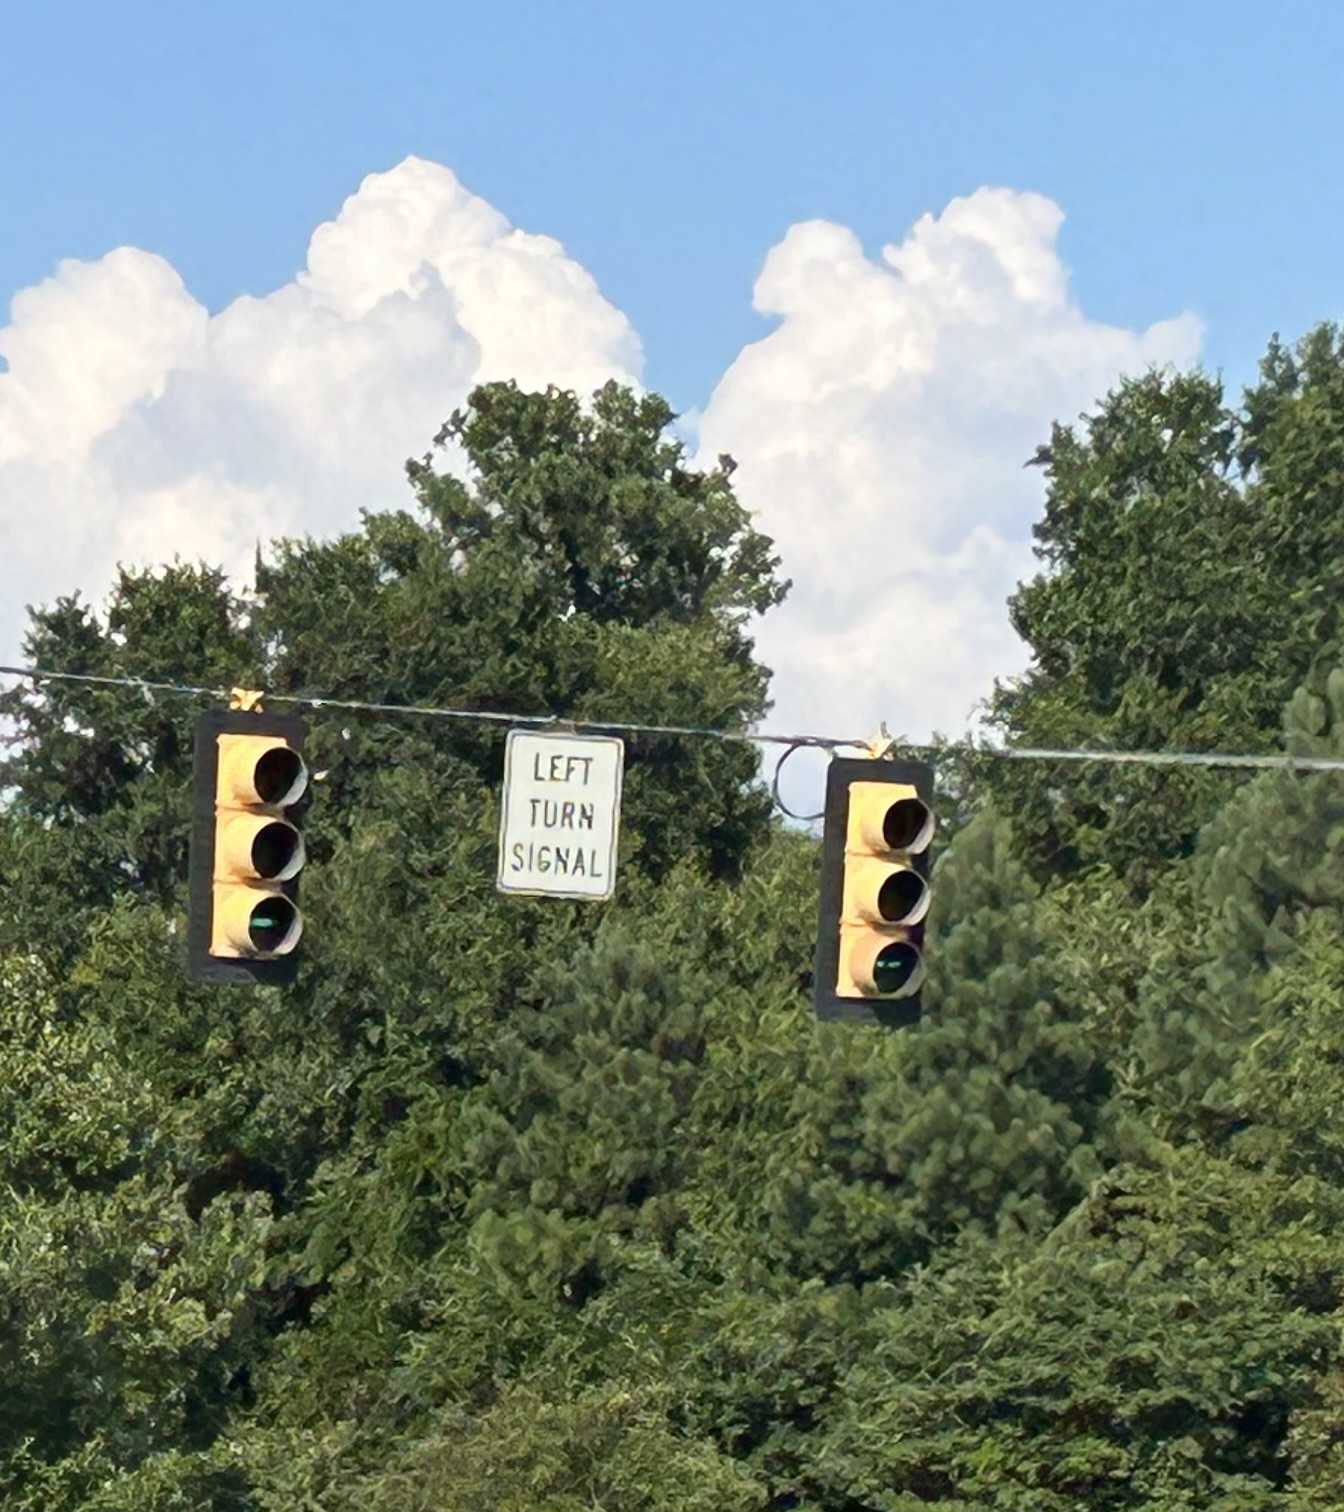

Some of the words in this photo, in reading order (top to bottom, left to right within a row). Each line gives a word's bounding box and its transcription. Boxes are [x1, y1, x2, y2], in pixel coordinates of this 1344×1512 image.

[534, 752, 594, 785] LEFT
[529, 798, 594, 830] TURN
[511, 842, 603, 878] SIGNAL
